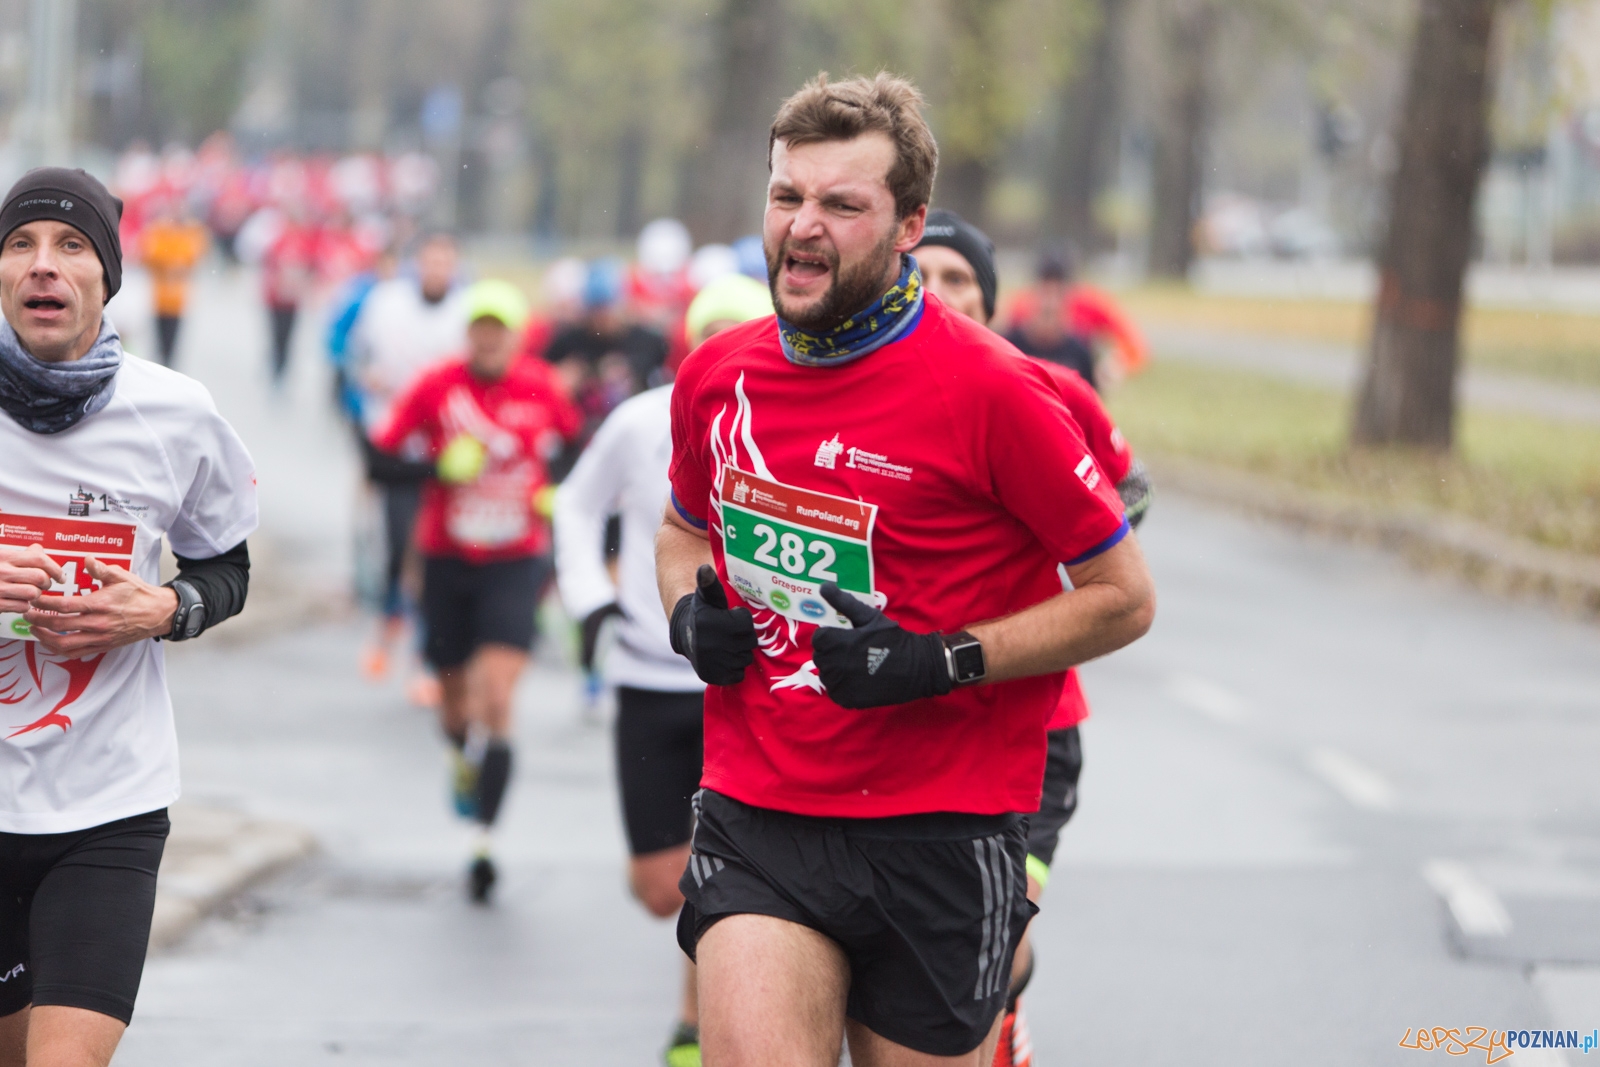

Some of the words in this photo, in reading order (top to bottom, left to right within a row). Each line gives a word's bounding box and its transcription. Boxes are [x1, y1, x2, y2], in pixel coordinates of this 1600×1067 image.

[18, 198, 57, 208] ARTENGO
[845, 446, 857, 469] 1
[99, 494, 109, 512] 1
[751, 488, 757, 503] 1
[796, 505, 860, 531] RunPoland.org
[55, 532, 123, 547] RunPoland.org
[727, 524, 737, 539] C
[753, 523, 838, 582] 282
[771, 575, 813, 595] Grzegorz
